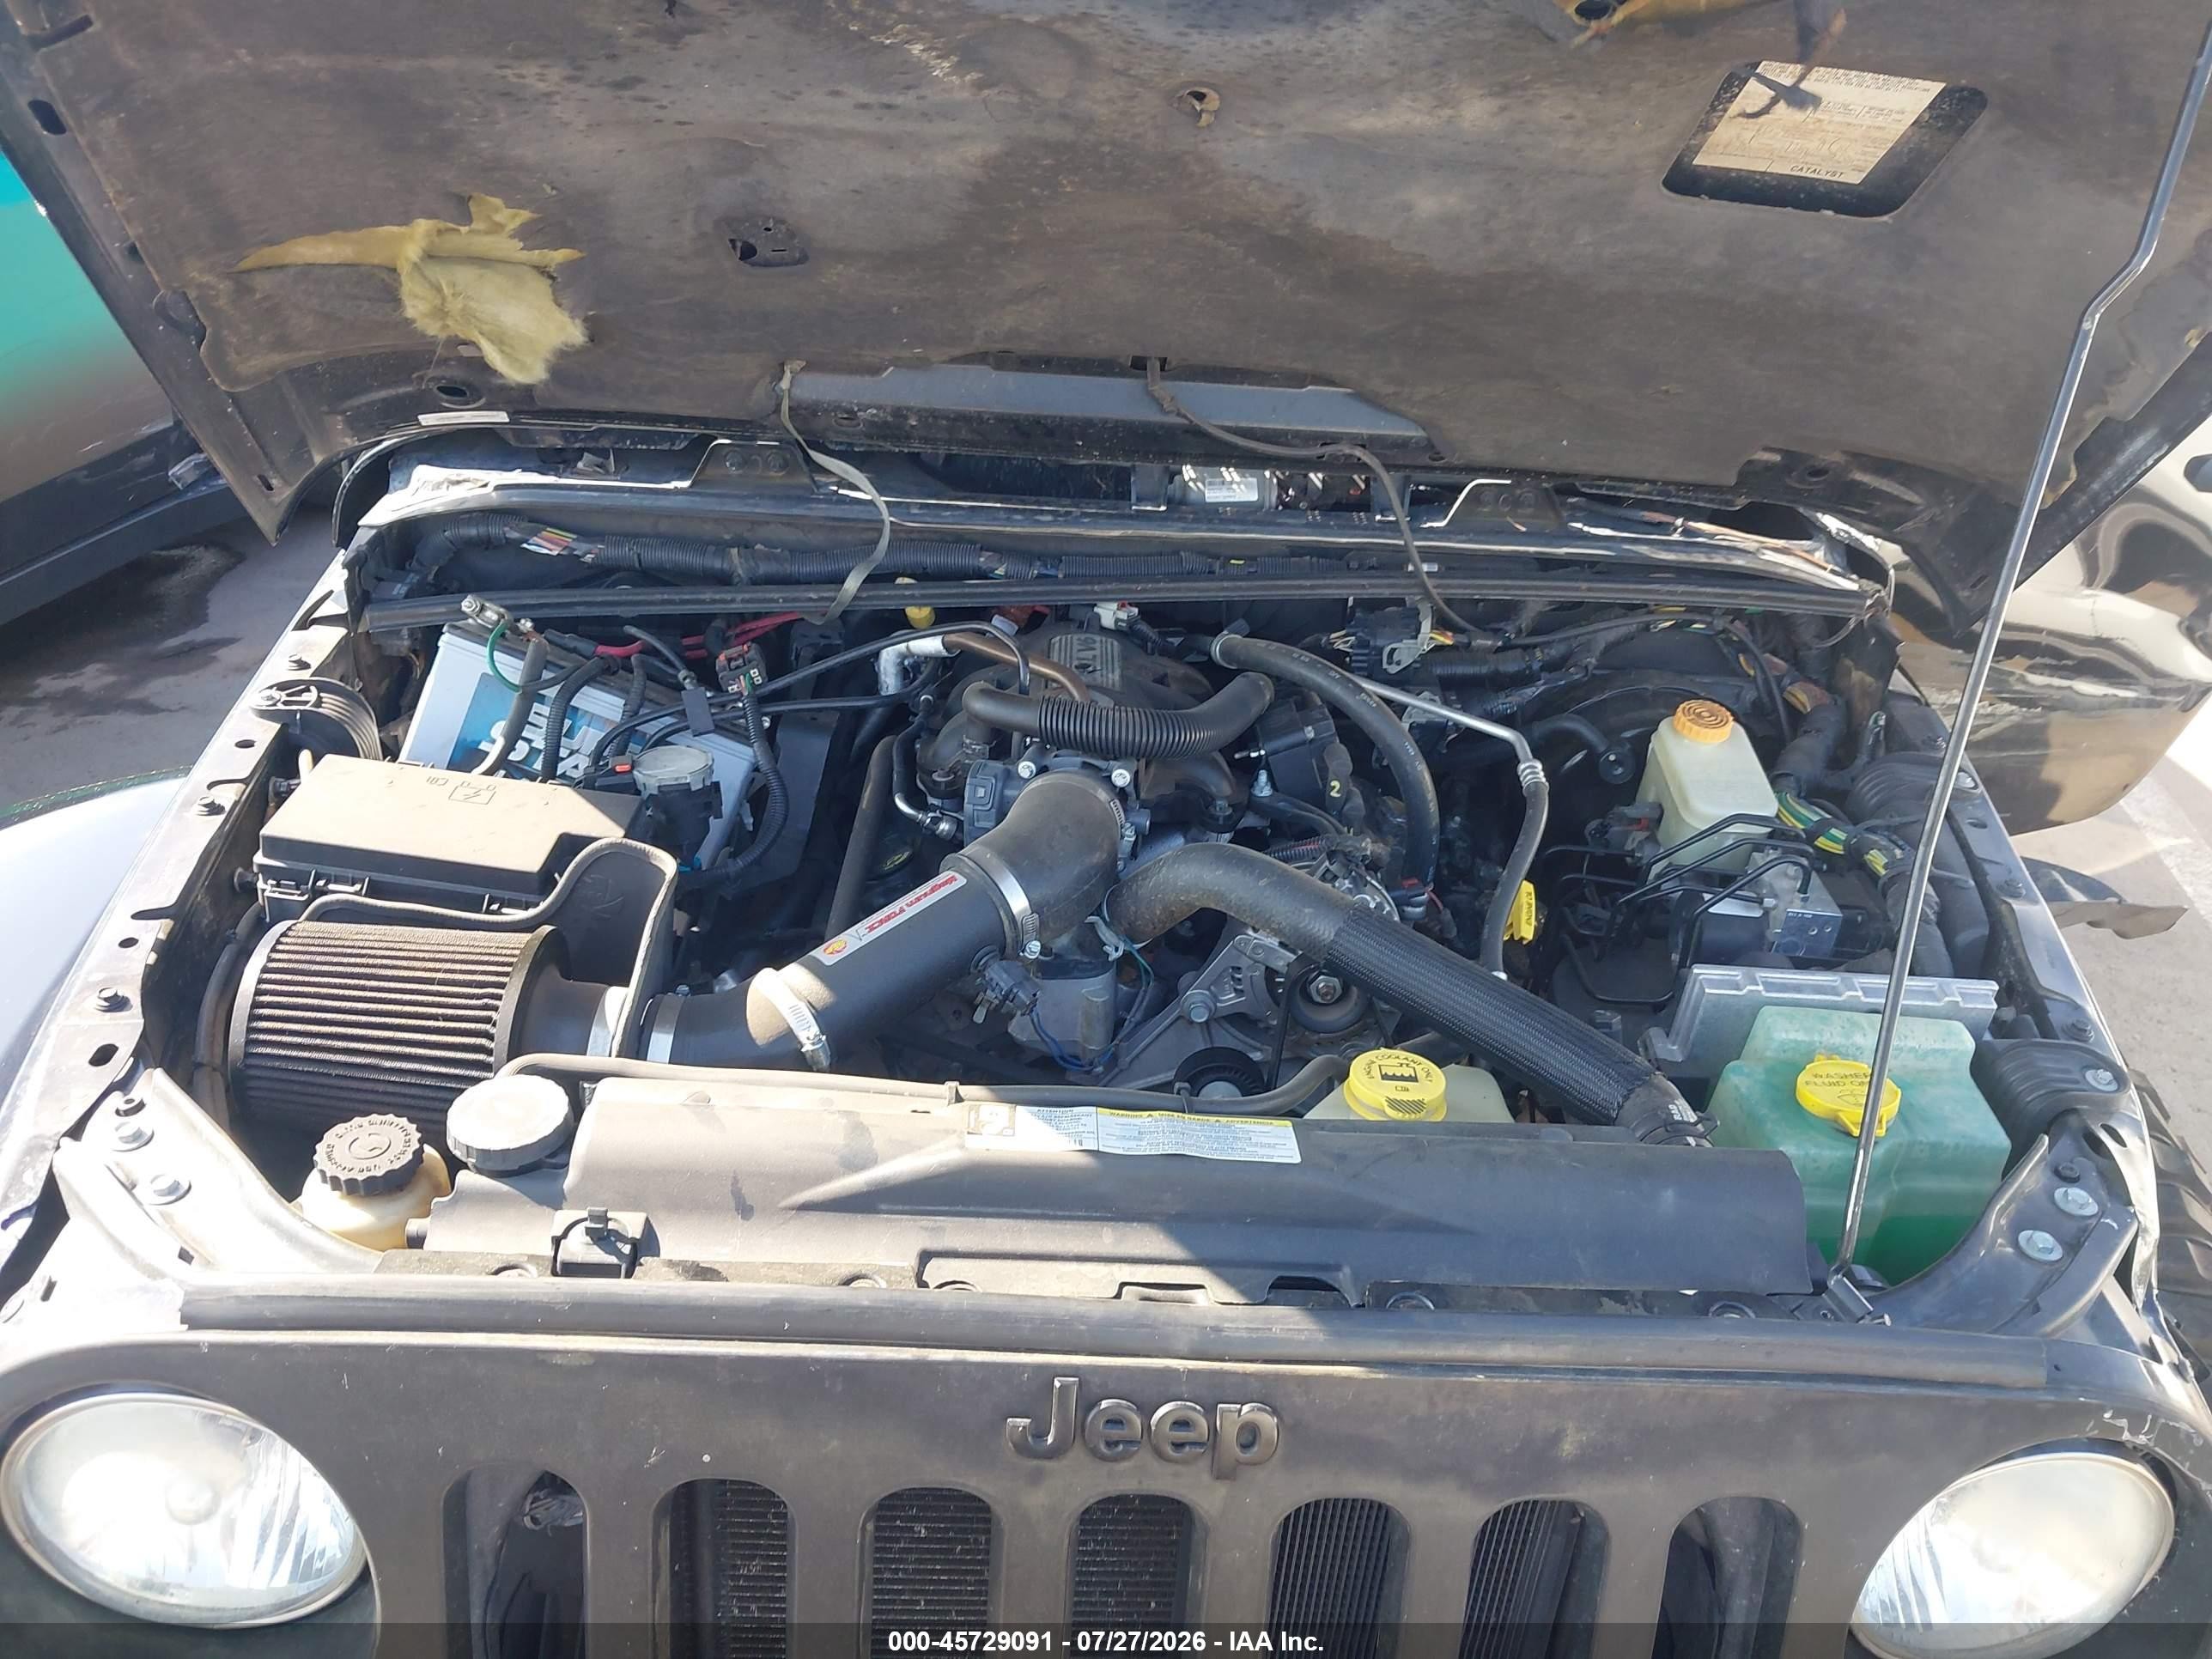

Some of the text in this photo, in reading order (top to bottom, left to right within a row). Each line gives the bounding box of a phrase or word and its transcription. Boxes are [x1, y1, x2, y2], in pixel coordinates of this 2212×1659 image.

[1790, 165, 1844, 179] CATALYST
[1329, 780, 1341, 798] 2
[1006, 1376, 1280, 1480] Jeep
